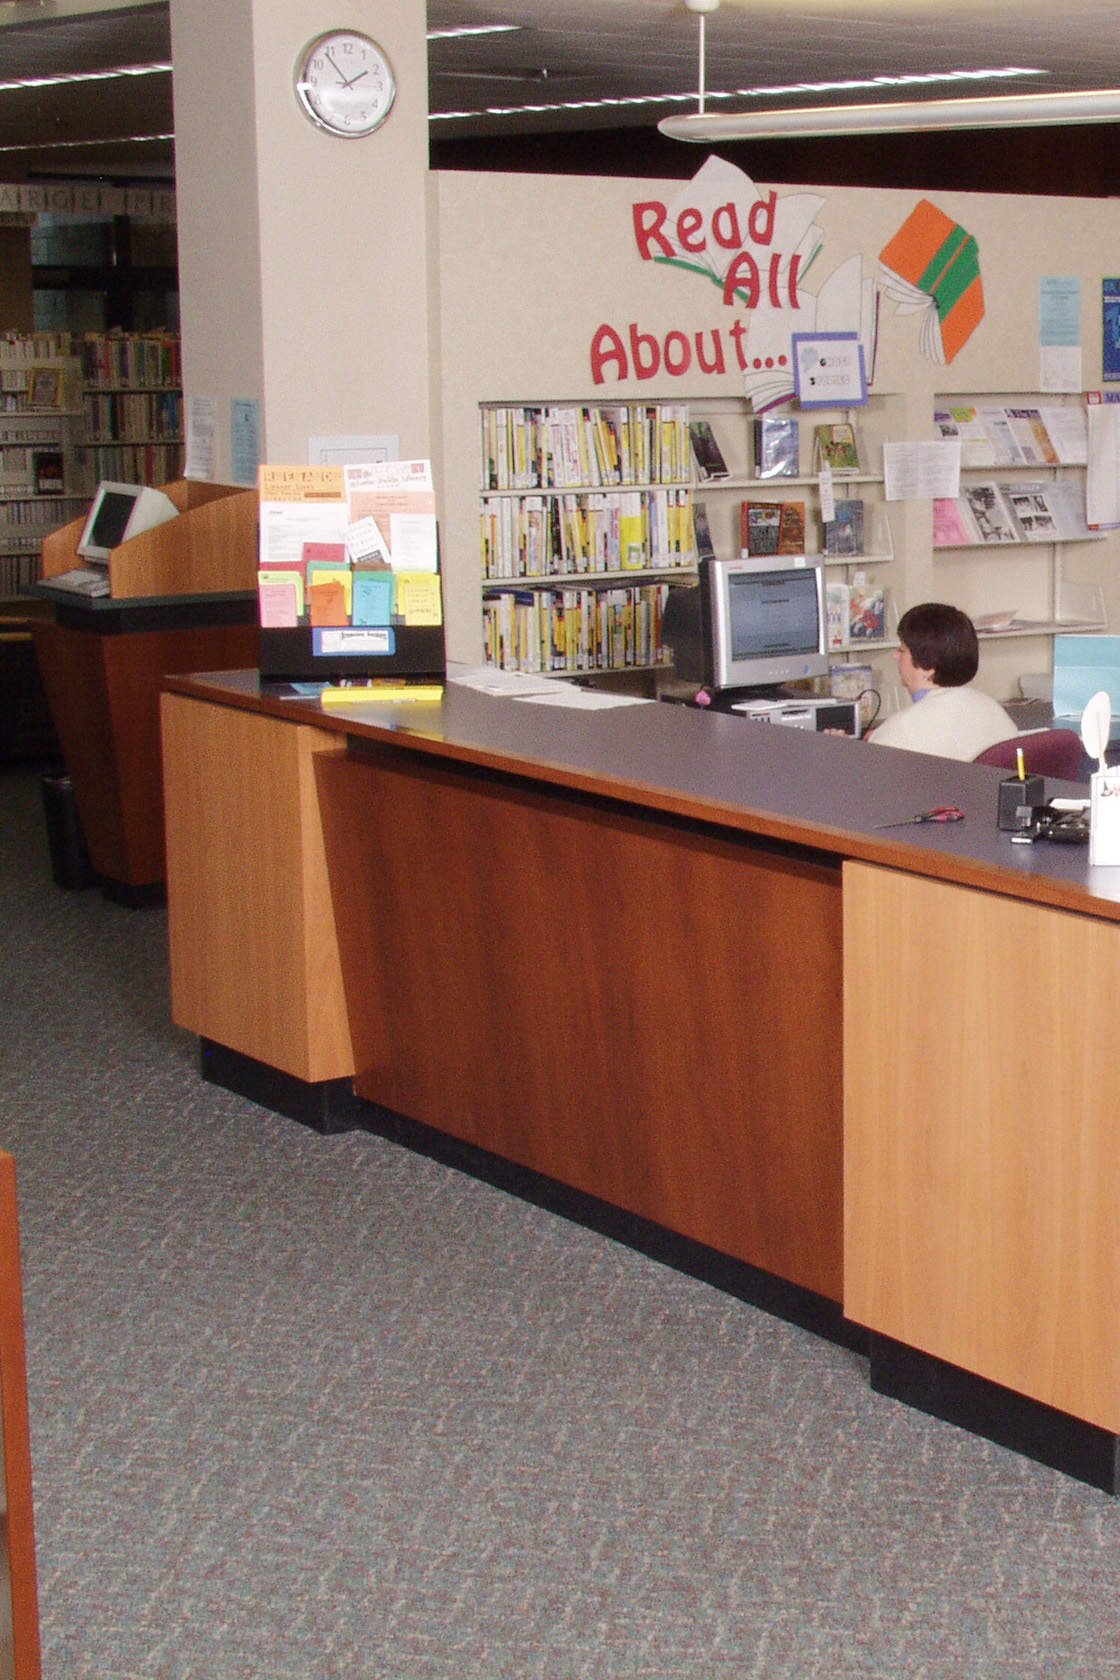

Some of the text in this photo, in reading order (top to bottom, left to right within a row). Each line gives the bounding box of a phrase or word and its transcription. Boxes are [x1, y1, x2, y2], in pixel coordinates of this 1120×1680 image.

[326, 47, 335, 56] 11
[342, 43, 353, 54] 12
[313, 59, 323, 69] 10
[373, 64, 380, 75] 2
[310, 77, 317, 87] 9
[377, 81, 383, 92] 3
[344, 115, 351, 126] 6
[360, 112, 367, 121] 5
[632, 190, 778, 261] Read
[722, 251, 801, 309] All
[589, 319, 788, 385] About...
